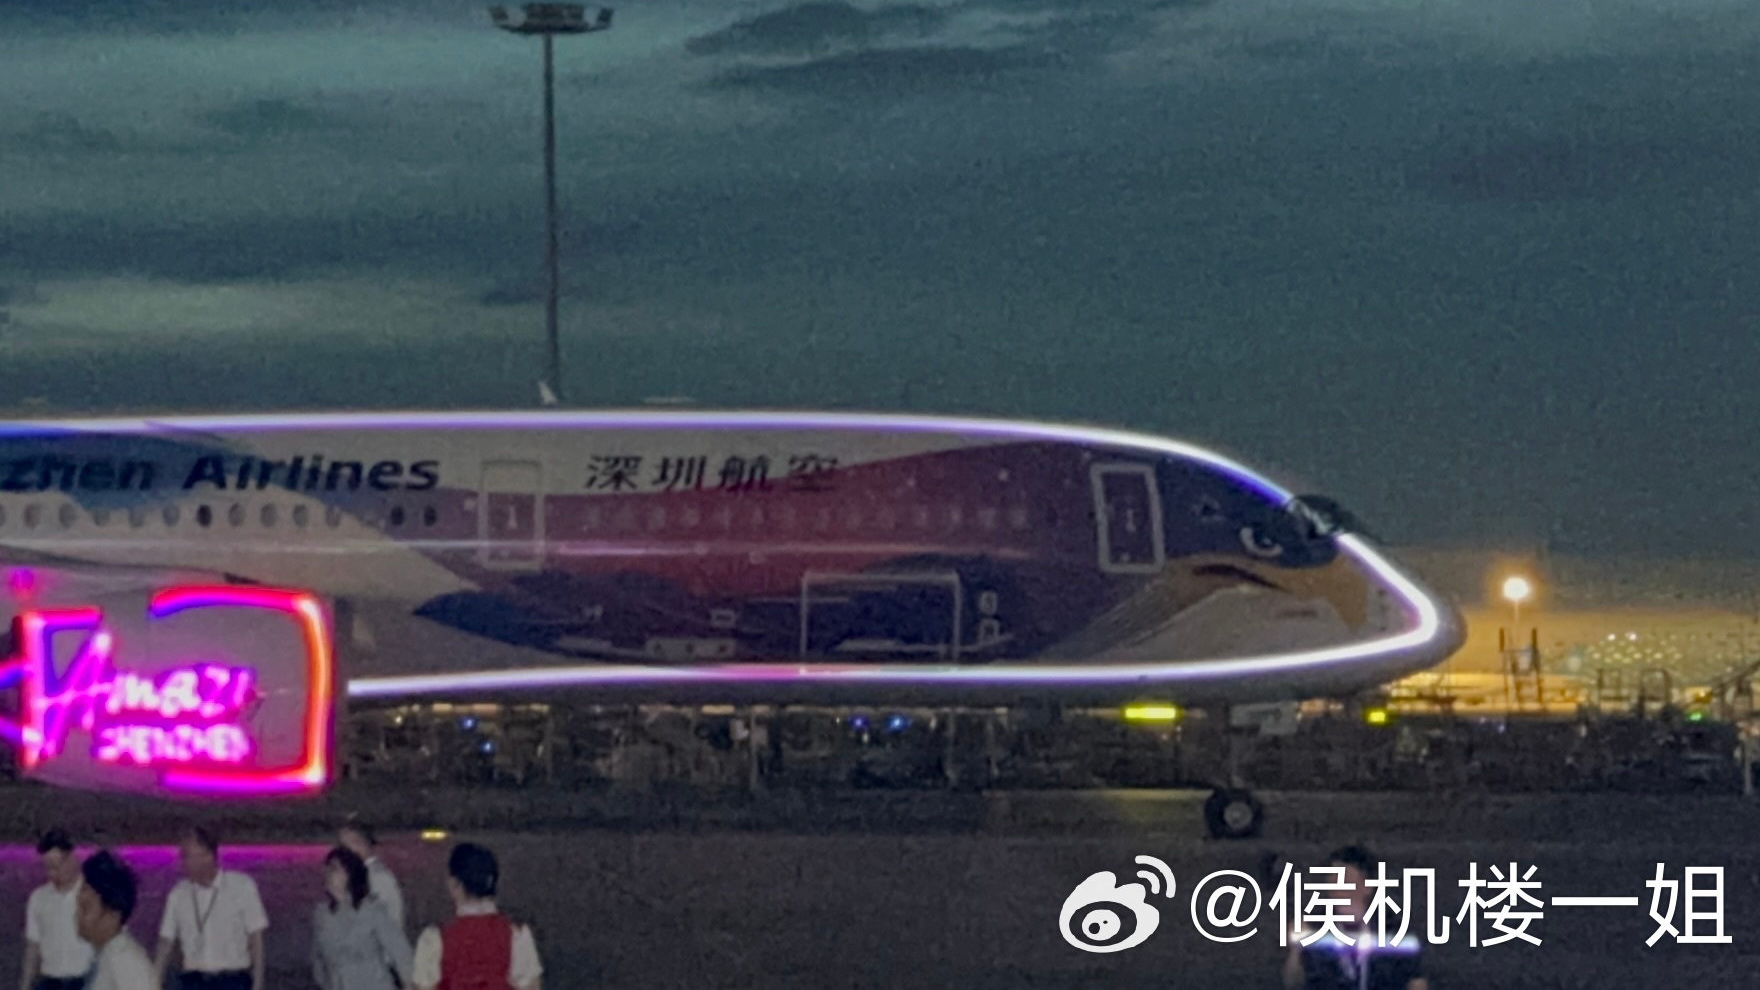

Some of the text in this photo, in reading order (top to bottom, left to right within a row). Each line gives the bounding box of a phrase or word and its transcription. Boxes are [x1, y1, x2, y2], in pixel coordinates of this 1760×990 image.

[182, 453, 439, 492] Airlines
[582, 454, 840, 494] 深圳航空
[97, 724, 251, 766] SHENZHEN
